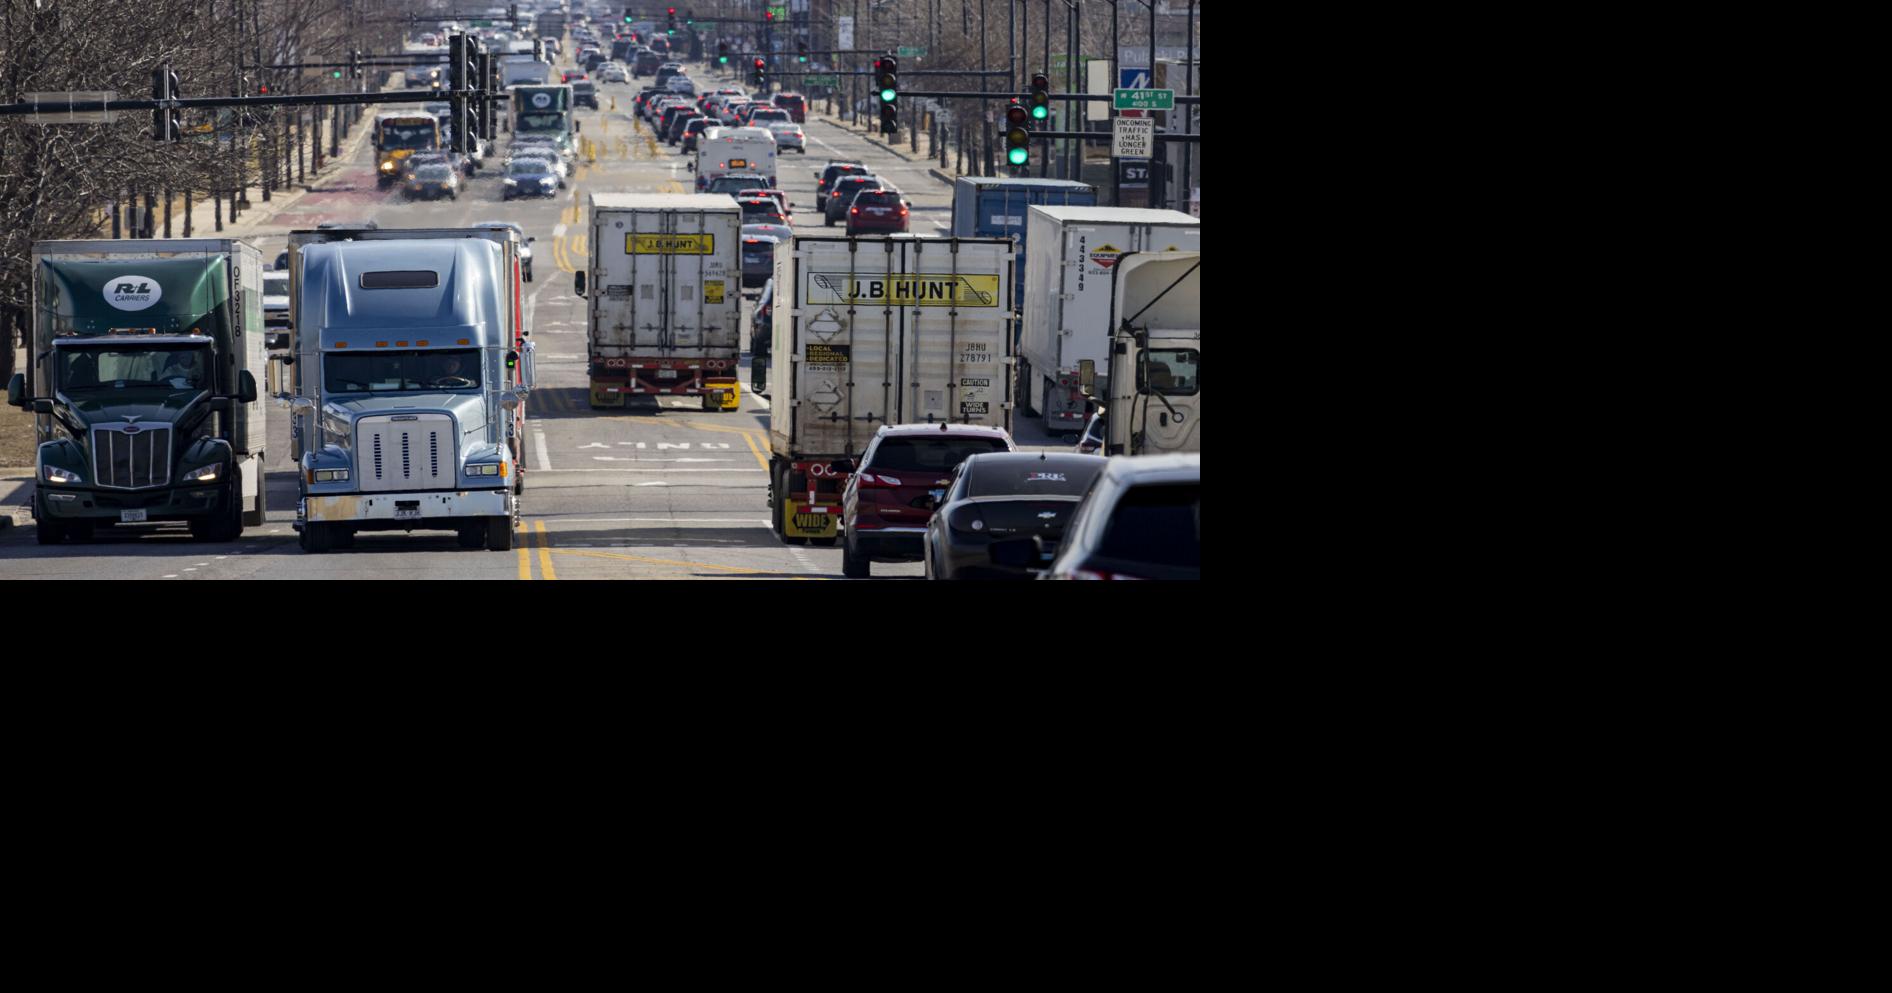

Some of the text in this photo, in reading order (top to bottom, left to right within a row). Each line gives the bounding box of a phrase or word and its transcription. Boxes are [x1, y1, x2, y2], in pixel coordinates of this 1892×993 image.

[665, 240, 693, 249] HUNT
[896, 281, 959, 299] HUNT
[114, 294, 150, 302] CARRIERS
[965, 343, 986, 352] JBHU
[960, 354, 991, 363] 278791
[796, 513, 827, 528] WIDE
